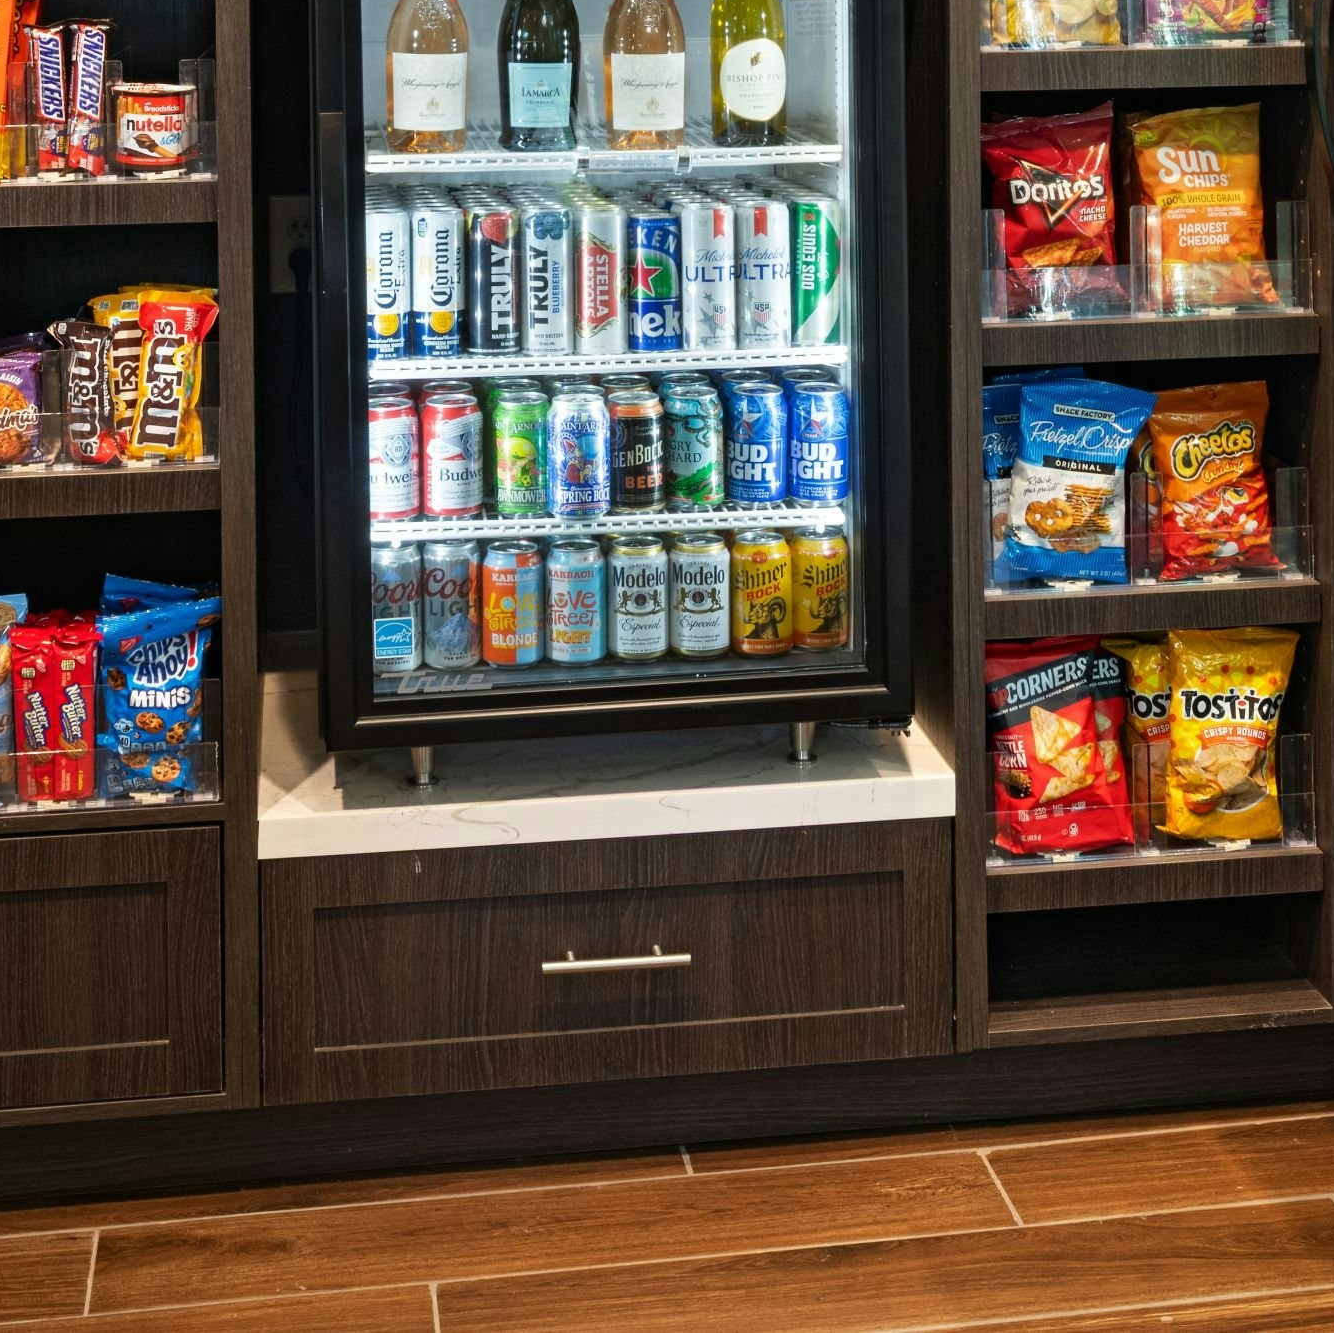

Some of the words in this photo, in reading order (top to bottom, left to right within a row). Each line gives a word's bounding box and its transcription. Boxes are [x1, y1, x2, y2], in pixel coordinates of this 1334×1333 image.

[38, 32, 64, 120] SNICKERS
[78, 27, 105, 118] SNICKERS
[126, 117, 182, 133] nutella
[1157, 146, 1220, 184] Sun
[1010, 175, 1105, 205] Doritos
[1184, 174, 1230, 187] CHIPS
[1080, 206, 1106, 214] NACHO
[1161, 196, 1186, 206] 100%
[1187, 194, 1214, 203] WHOLE
[1216, 193, 1241, 202] GRAIN
[1079, 213, 1106, 222] CHEESE
[1178, 222, 1228, 235] HARVEST
[803, 224, 816, 267] EQUIS
[1179, 234, 1230, 246] CHEDDAR
[374, 229, 398, 309] Corona
[431, 228, 453, 306] Corona
[491, 246, 512, 331] TRULY
[530, 246, 549, 330] TRULY
[552, 260, 560, 313] BLUEBERRY
[596, 254, 609, 317] STELLA
[802, 270, 815, 290] DOS
[1172, 425, 1255, 478] Cheetos
[1055, 459, 1102, 472] ORIGINAL
[625, 474, 664, 489] BEER
[548, 569, 595, 578] KARBACH
[613, 565, 665, 588] Modelo
[672, 562, 724, 585] Modelo
[746, 584, 781, 602] BOCK
[620, 618, 660, 634] Especial
[492, 633, 538, 646] BLONDE
[1181, 688, 1283, 722] TOSTITOS
[1204, 727, 1233, 738] CRISPY
[1236, 726, 1267, 740] ROUNDS
